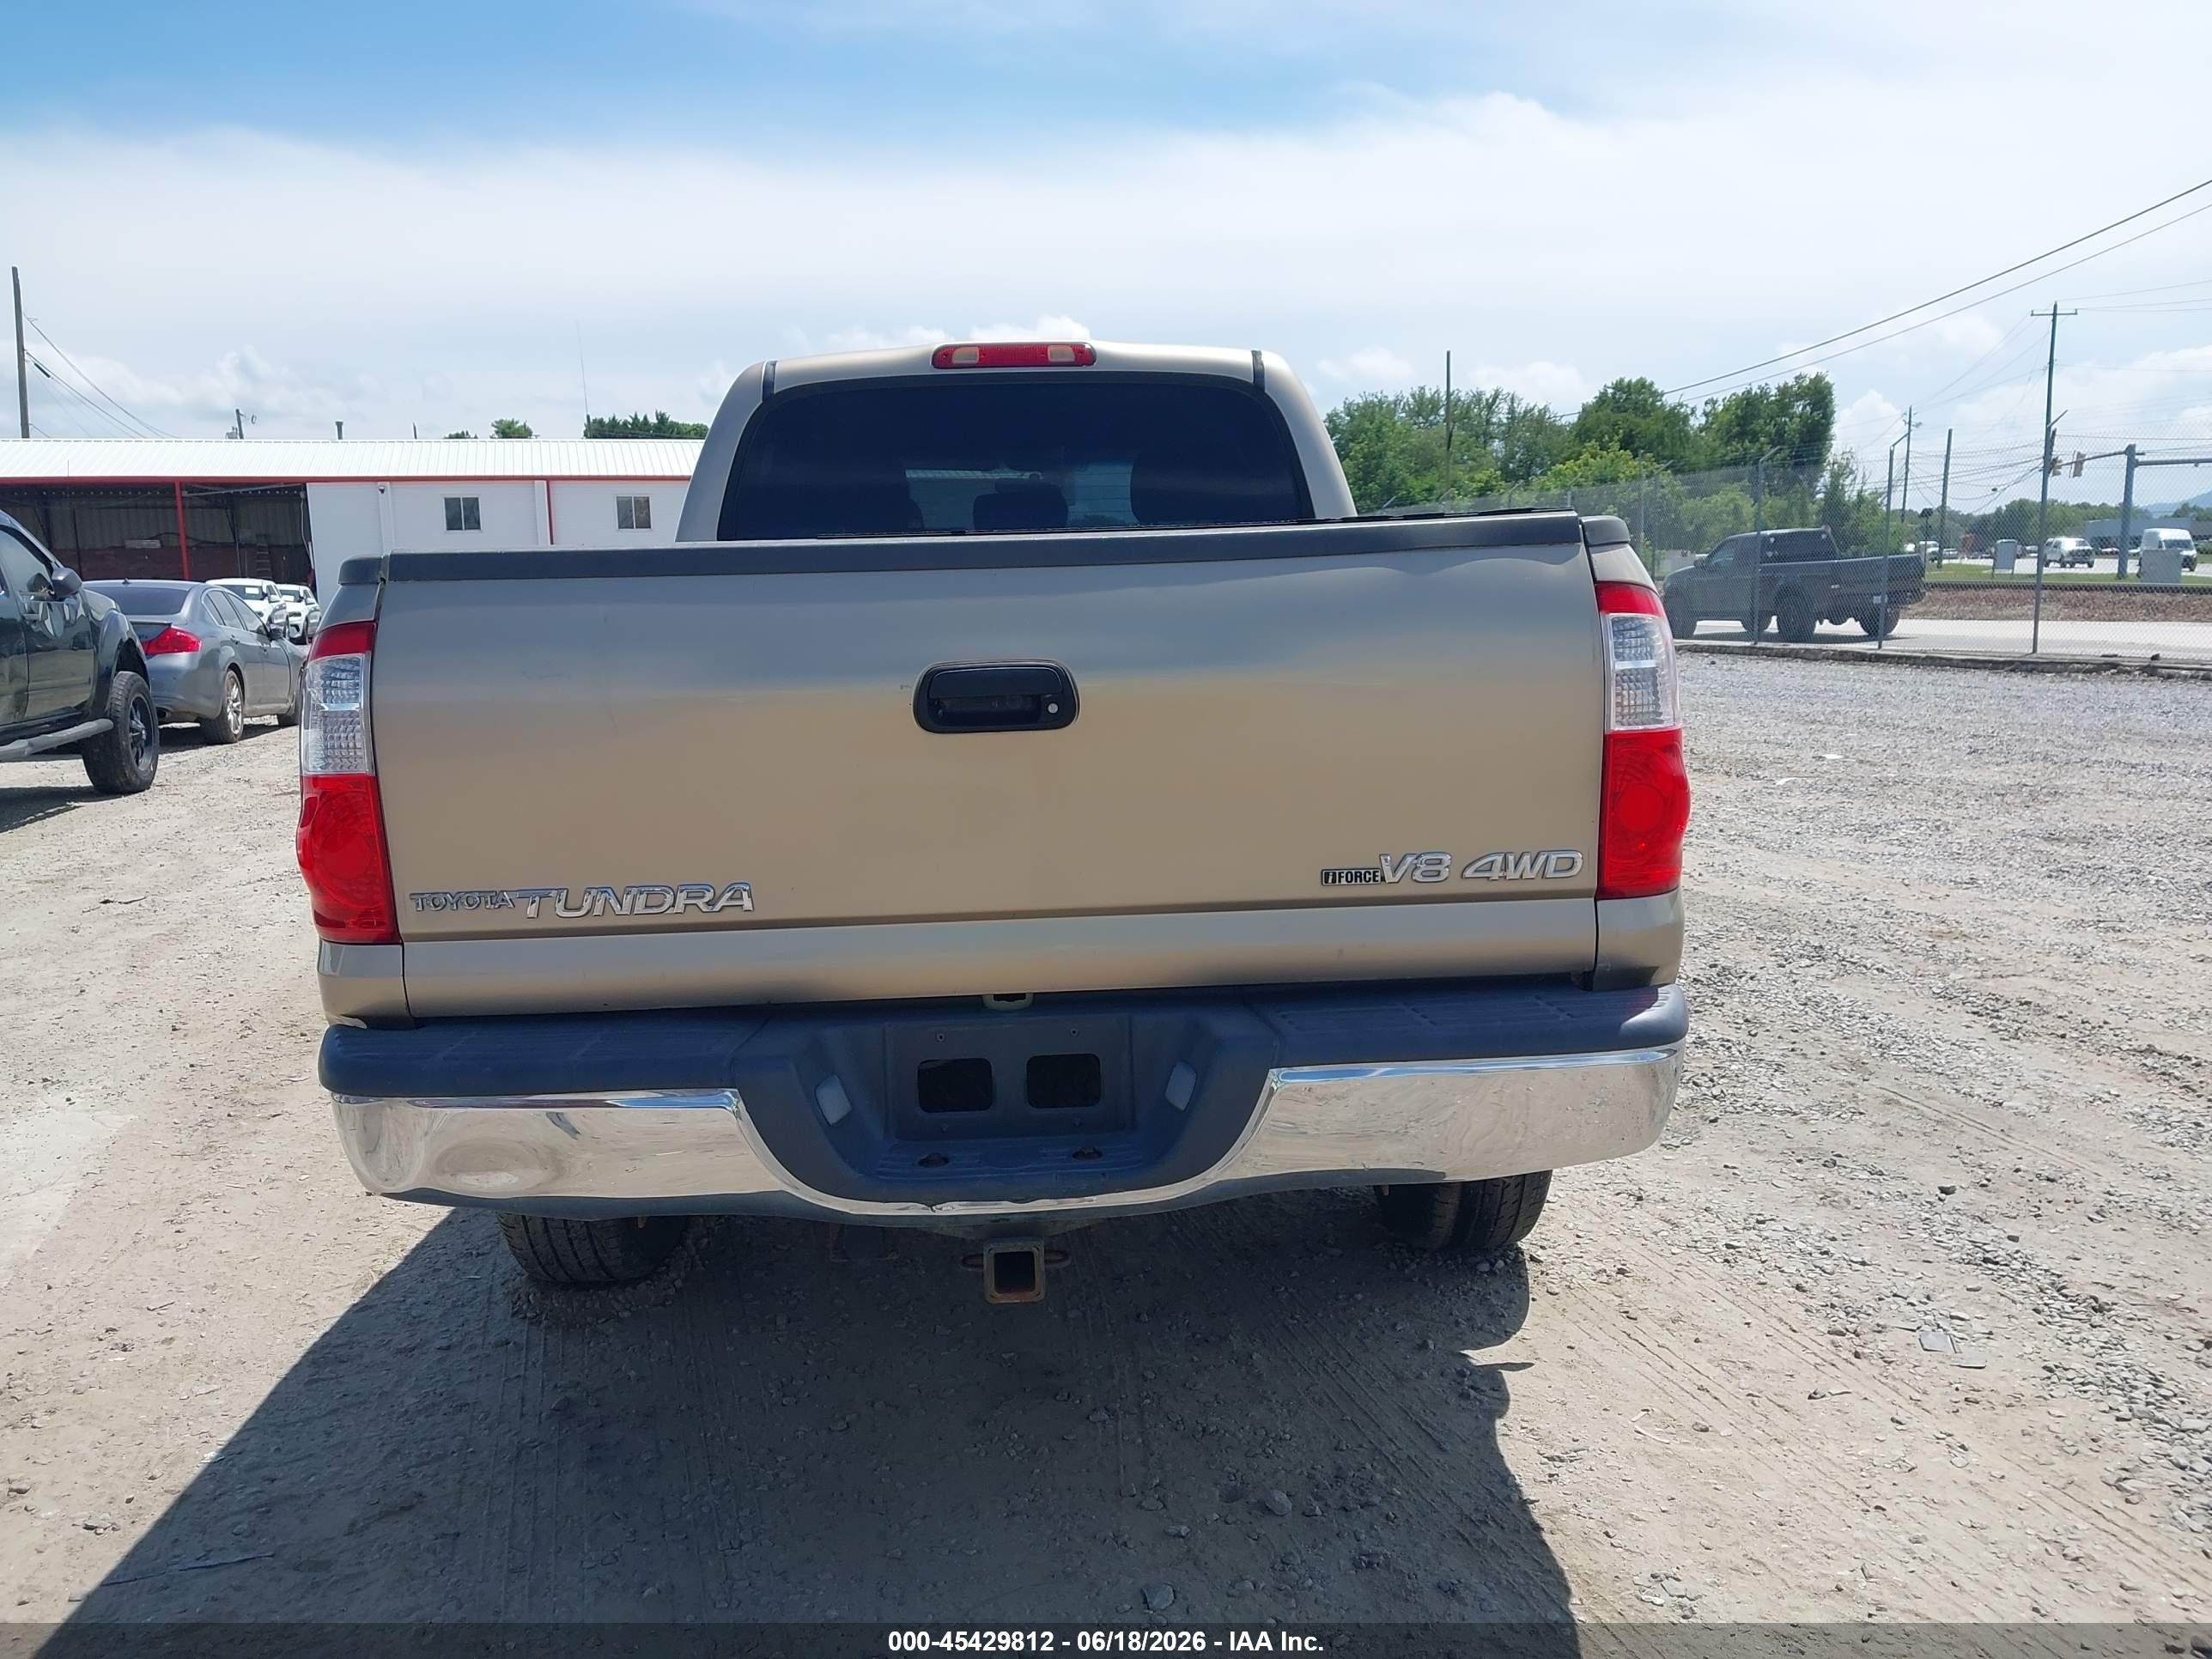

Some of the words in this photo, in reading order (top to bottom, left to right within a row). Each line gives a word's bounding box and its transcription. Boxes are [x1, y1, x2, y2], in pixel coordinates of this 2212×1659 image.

[1379, 852, 1452, 884] V8
[1462, 849, 1584, 881] 4WD
[410, 890, 515, 912] TOYOTA
[515, 882, 754, 920] TUNDRA
